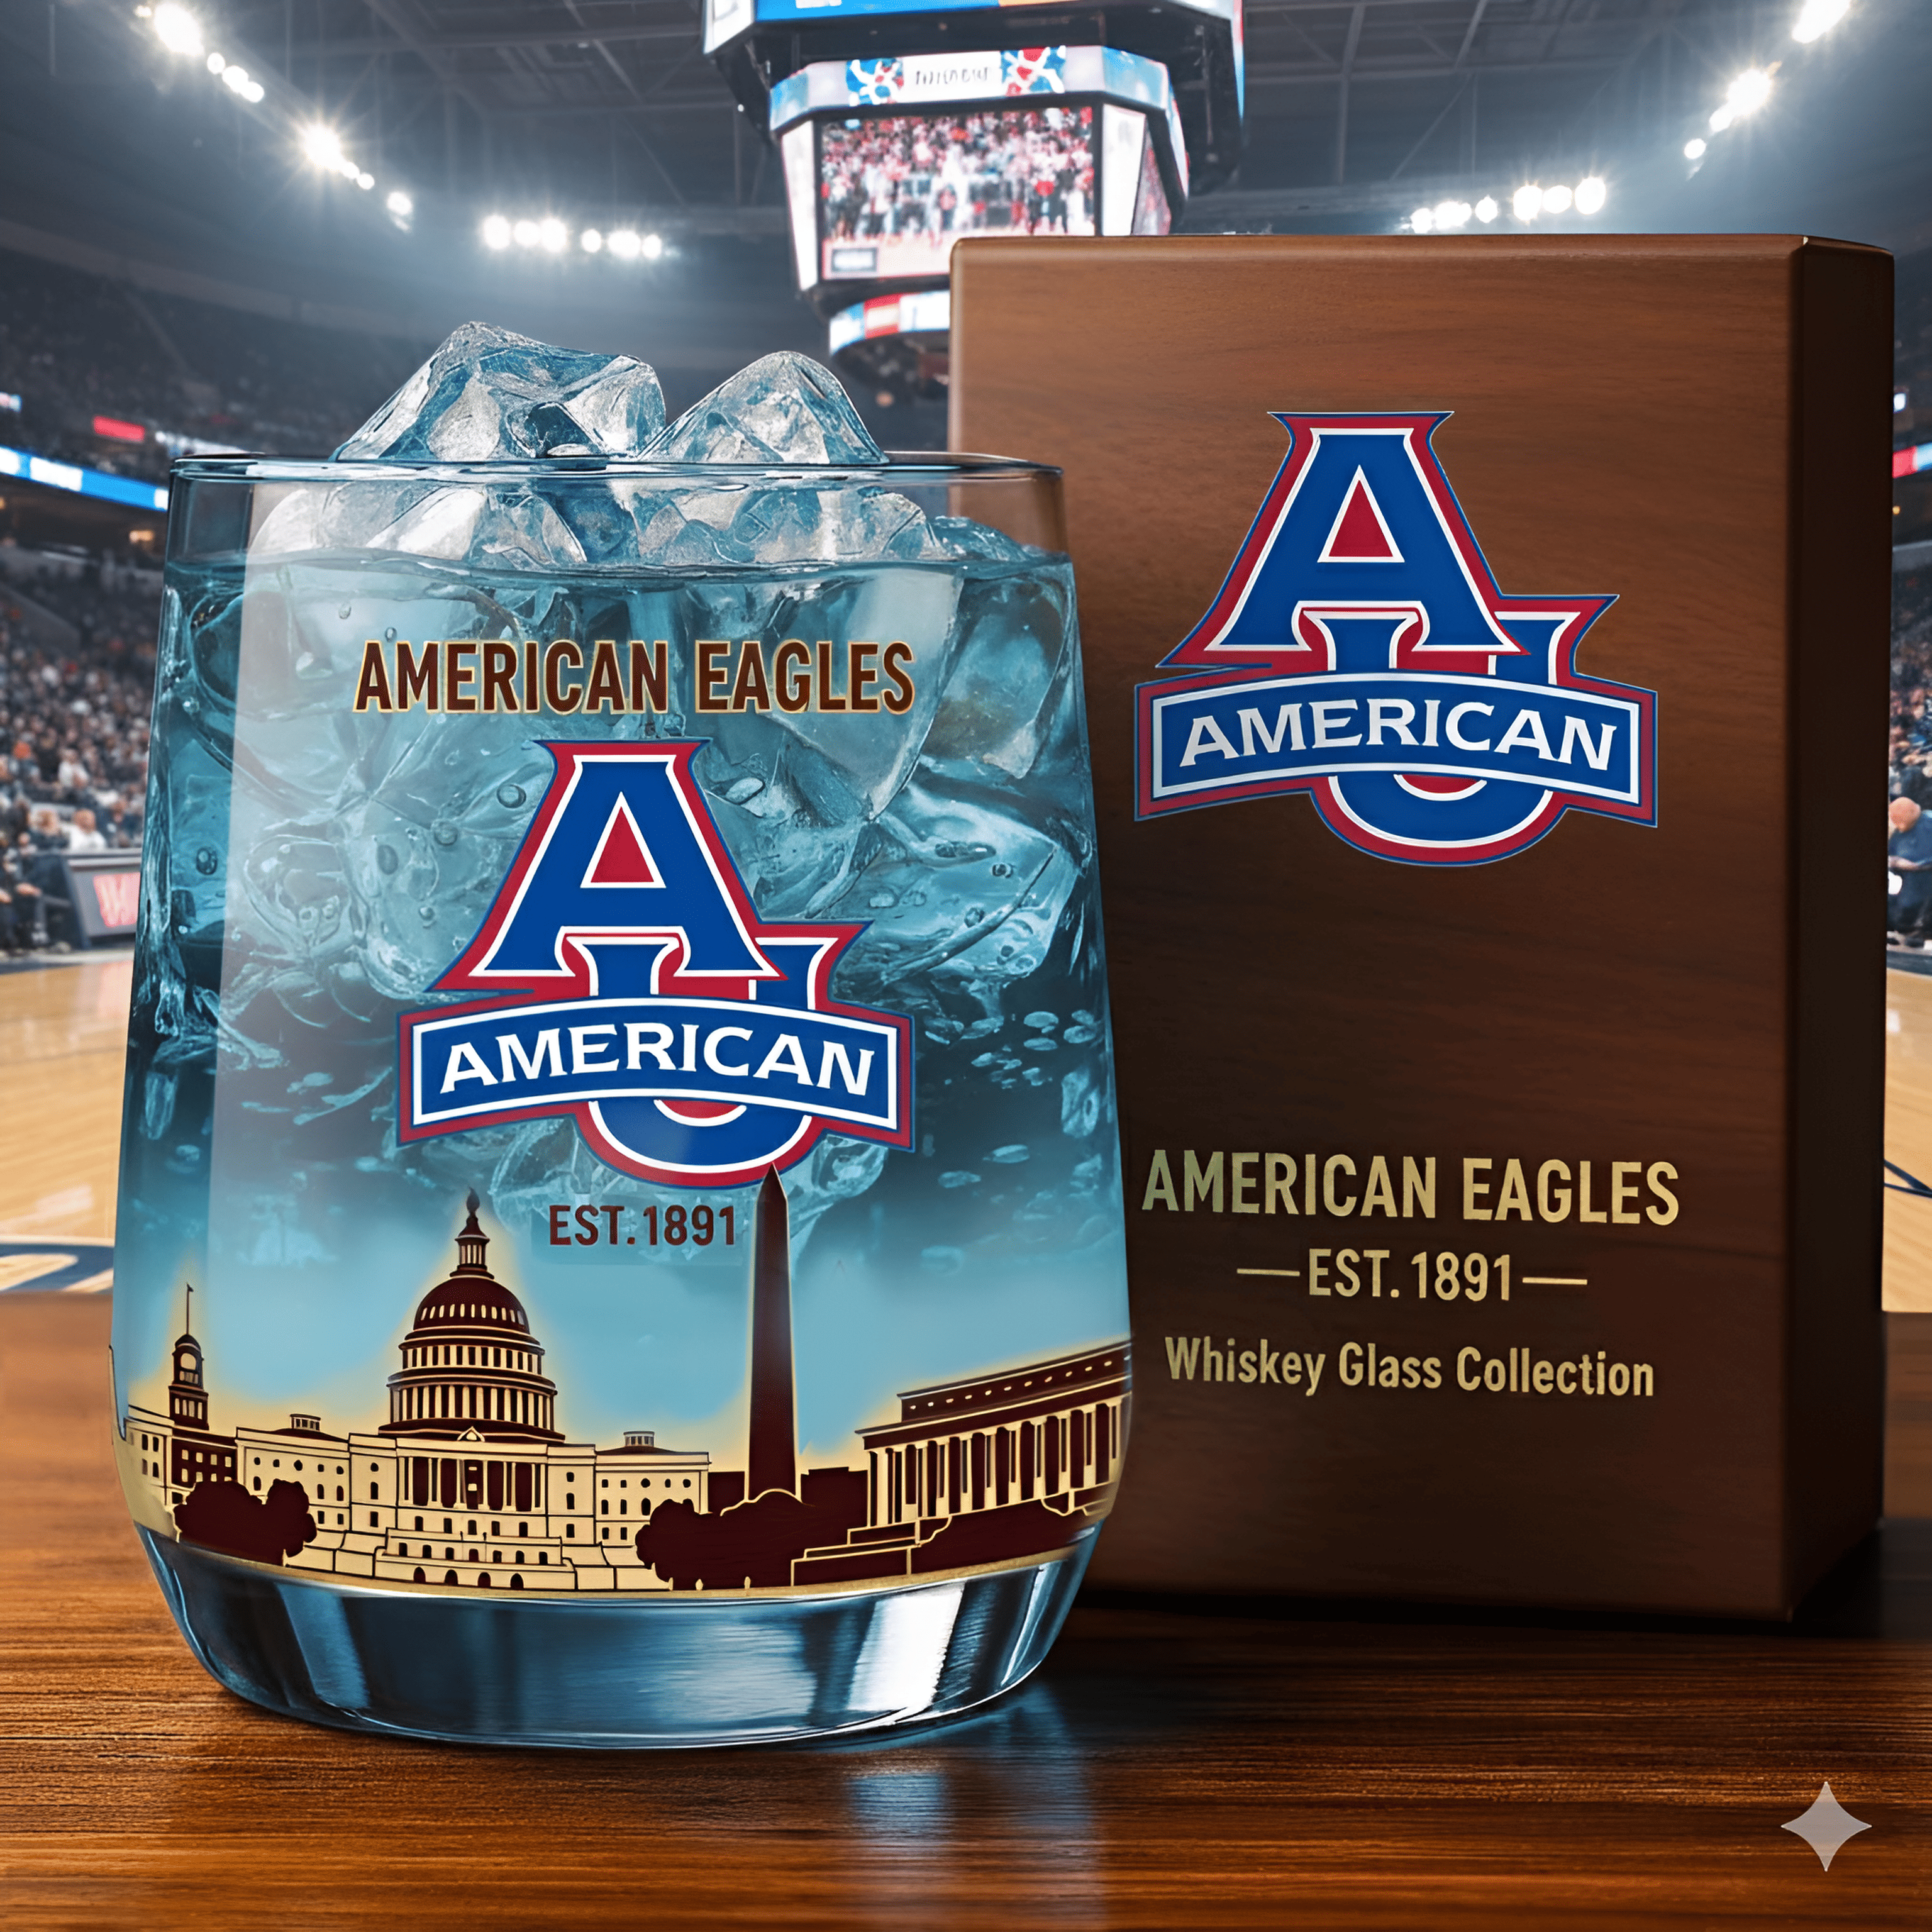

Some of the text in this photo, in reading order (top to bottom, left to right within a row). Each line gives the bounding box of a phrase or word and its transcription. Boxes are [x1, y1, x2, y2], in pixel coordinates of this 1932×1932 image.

[353, 640, 916, 715] AMERICAN EAGLES
[1180, 699, 1618, 771] AMERICAN
[440, 1023, 875, 1096] AMERICAN
[1142, 1149, 1680, 1226] AMERICAN EAGLES
[1165, 1336, 1654, 1397] Whiskey Glass Collection
